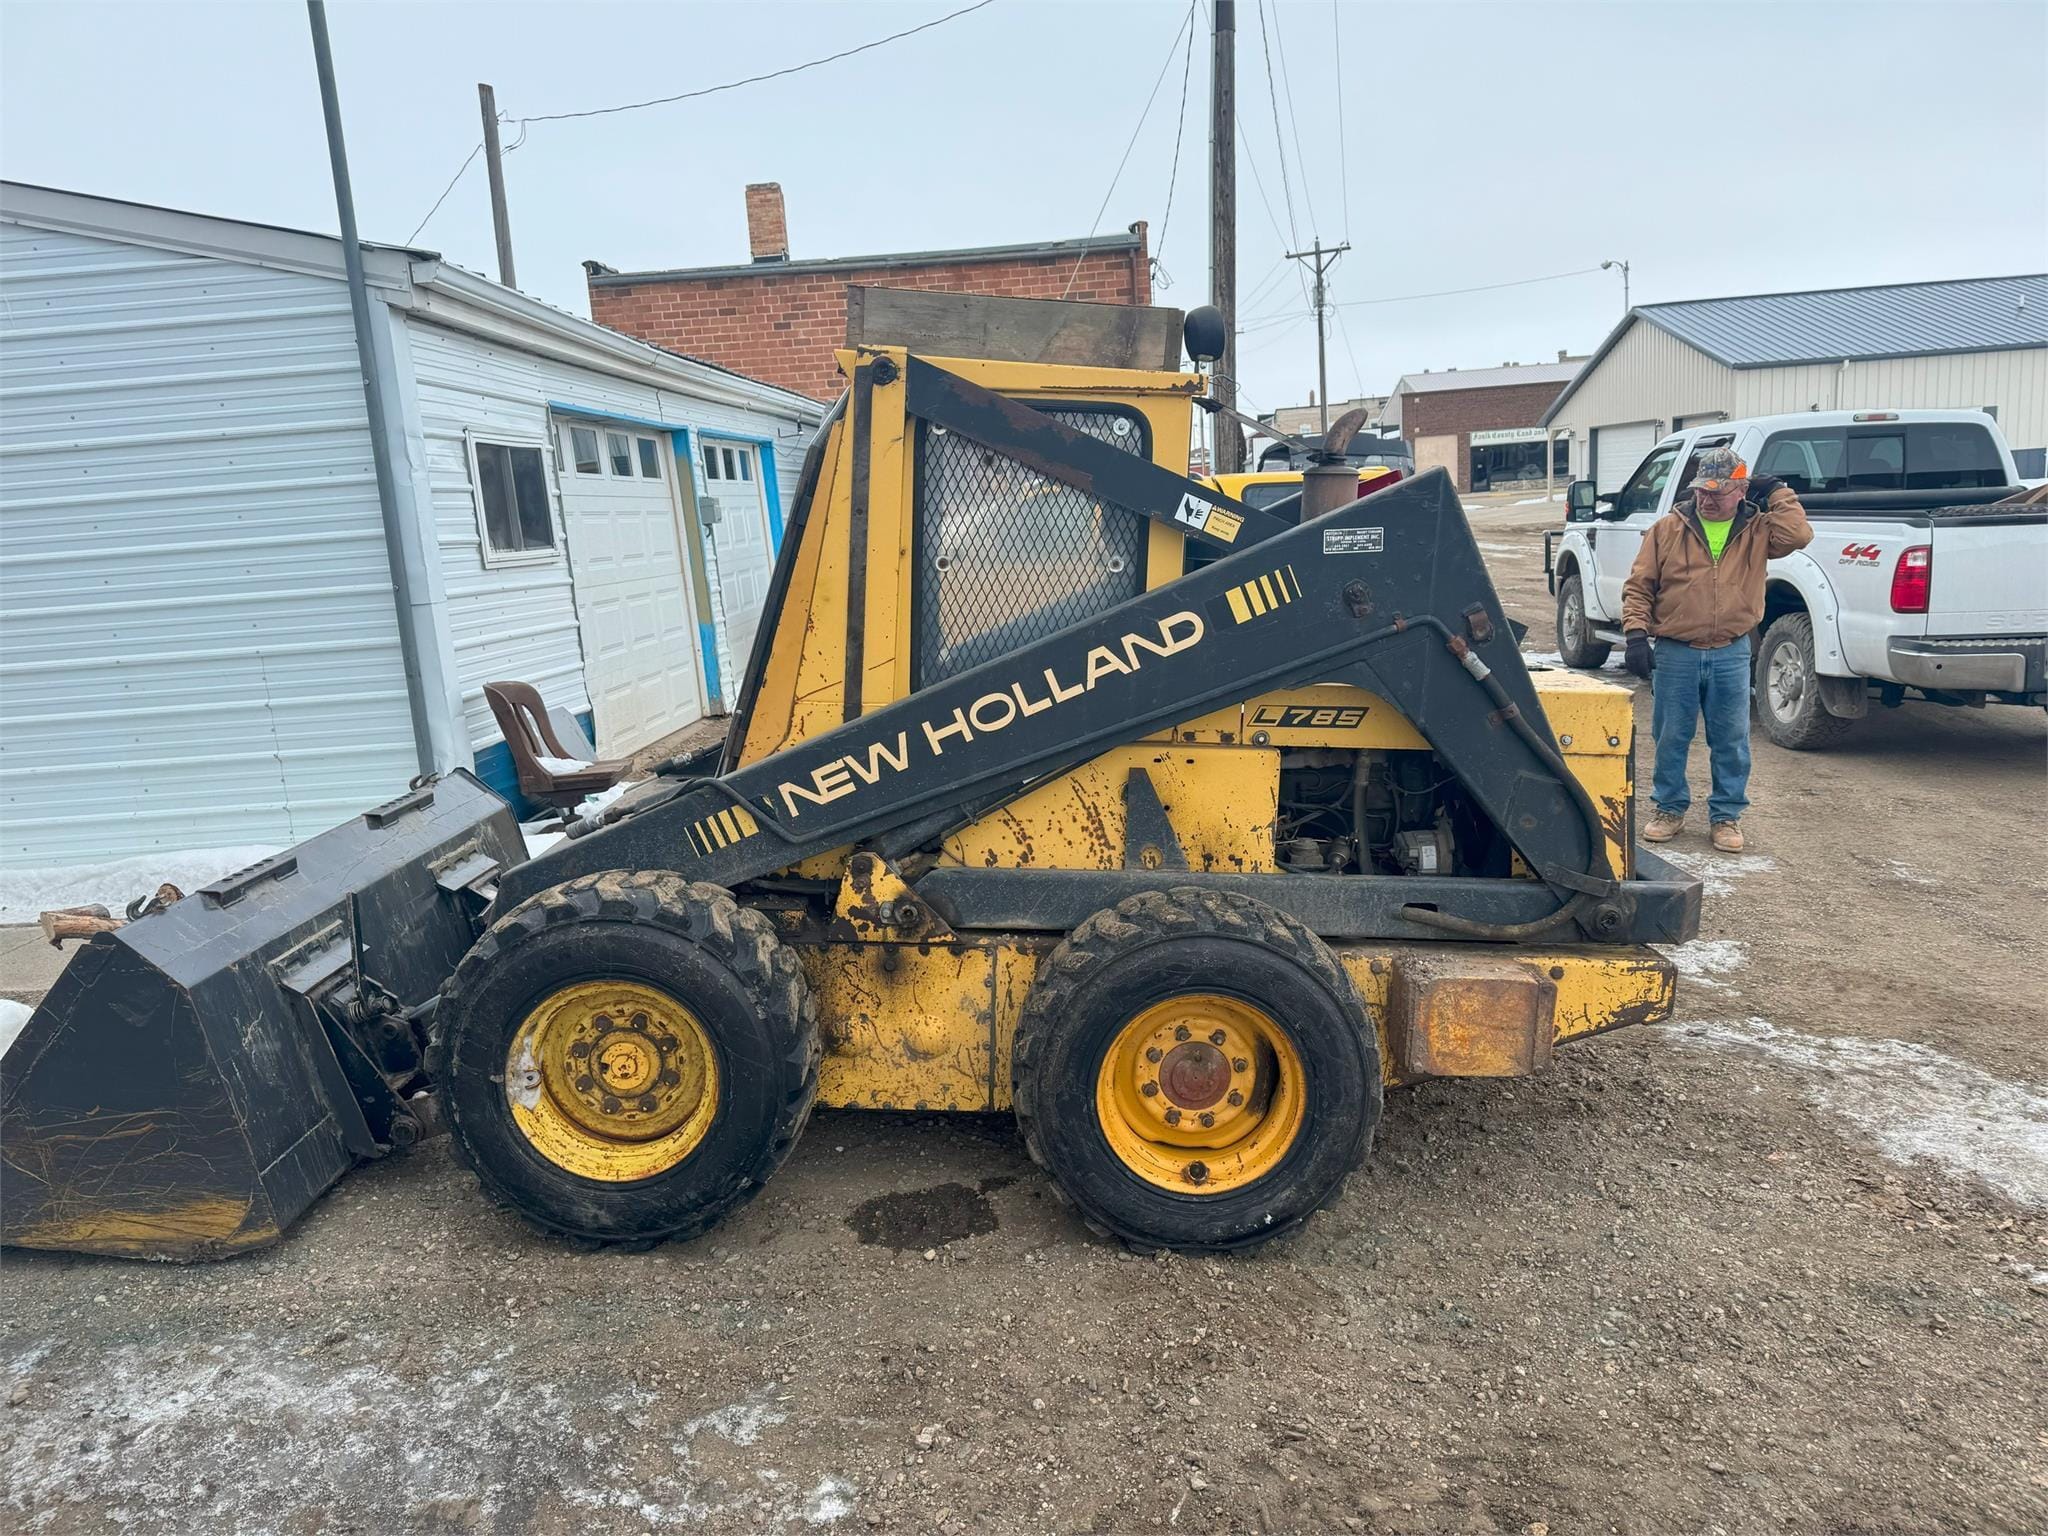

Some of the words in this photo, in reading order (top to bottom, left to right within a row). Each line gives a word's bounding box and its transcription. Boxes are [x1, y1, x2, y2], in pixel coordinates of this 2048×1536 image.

[1473, 432, 1491, 440] Faulk
[1492, 431, 1515, 439] County
[1517, 429, 1532, 437] Land
[1215, 505, 1245, 523] WARNING
[1838, 558, 1855, 566] OFF
[777, 732, 909, 818] NEW
[921, 611, 1205, 756] HOLLAND
